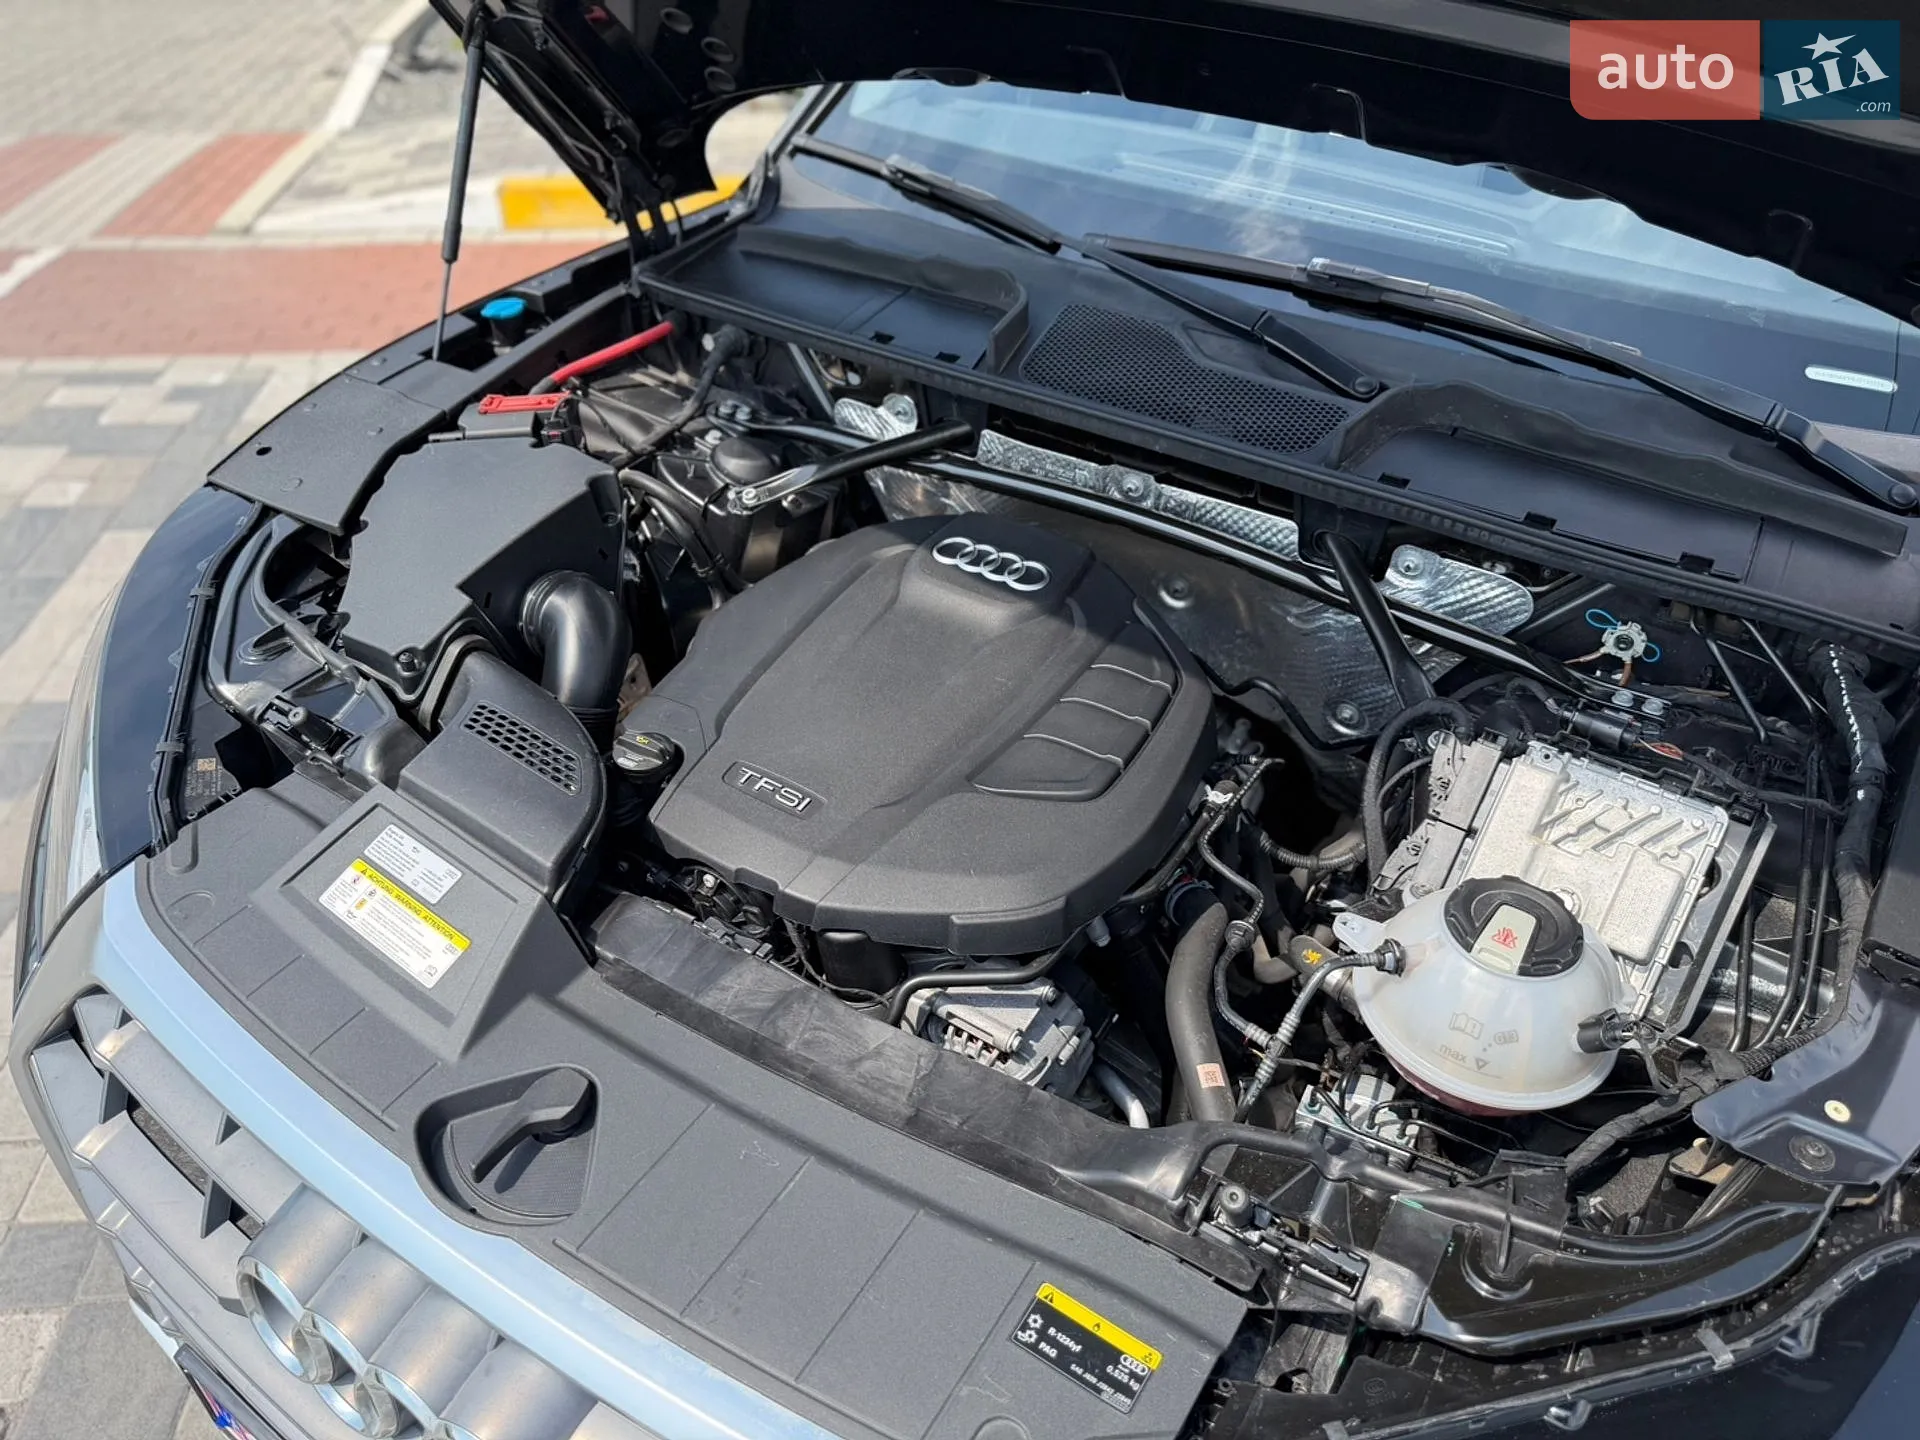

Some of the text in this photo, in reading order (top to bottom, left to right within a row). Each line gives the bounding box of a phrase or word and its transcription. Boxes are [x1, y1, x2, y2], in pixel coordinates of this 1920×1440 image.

[739, 767, 812, 812] TFSI
[368, 871, 393, 895] ACHTUNG
[394, 893, 421, 916] WARNING
[422, 912, 454, 940] ATTENTION
[1440, 1044, 1466, 1063] max
[1038, 1341, 1058, 1358] PAG
[1129, 1378, 1140, 1391] kg
